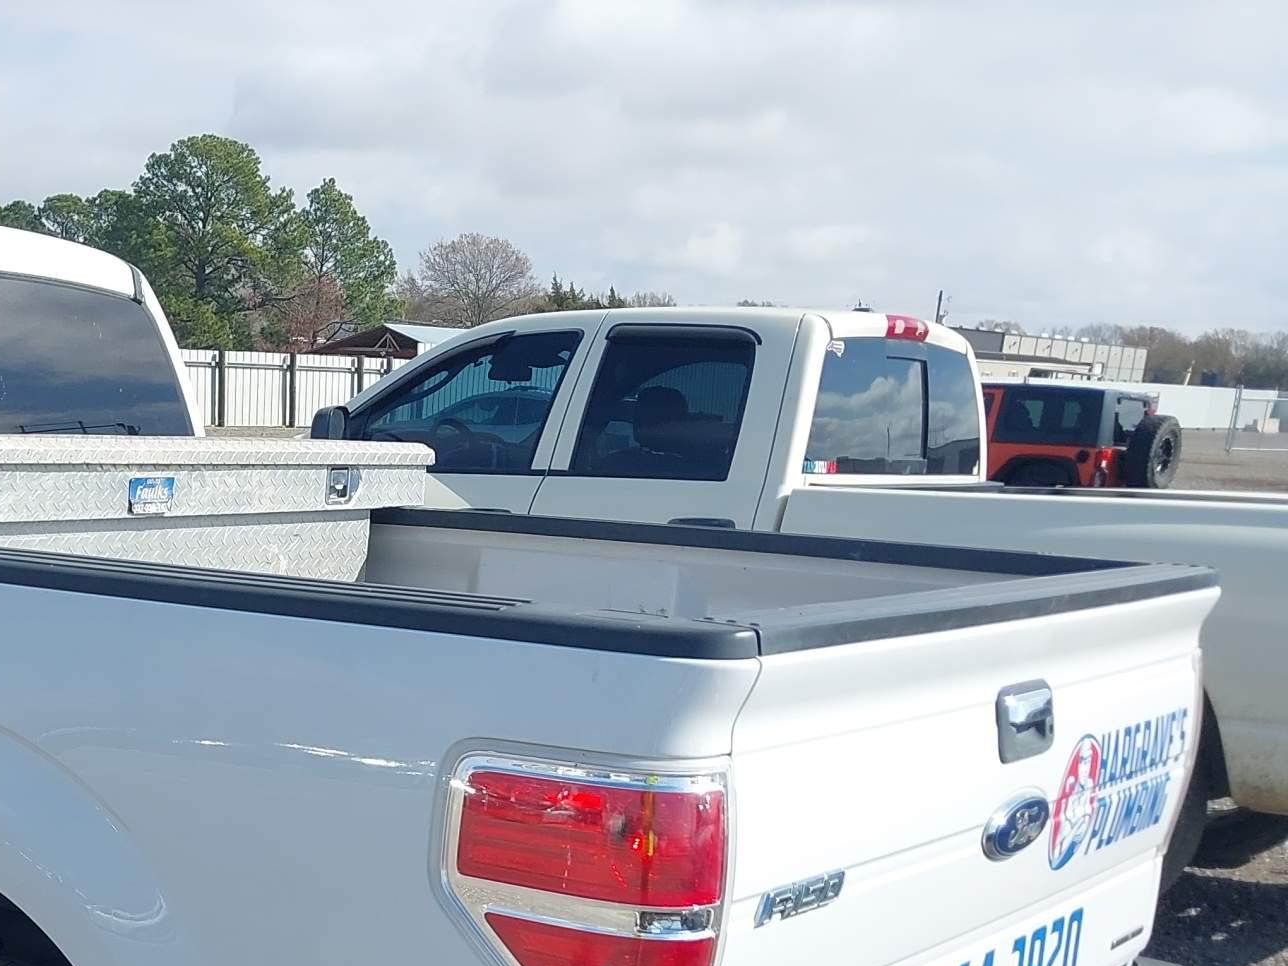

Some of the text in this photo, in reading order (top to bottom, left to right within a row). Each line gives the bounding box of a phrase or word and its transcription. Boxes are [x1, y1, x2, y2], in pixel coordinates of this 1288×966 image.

[134, 484, 169, 500] Faulks
[1096, 706, 1188, 789] HARGRAVE'S
[1083, 771, 1171, 856] PLUMBING
